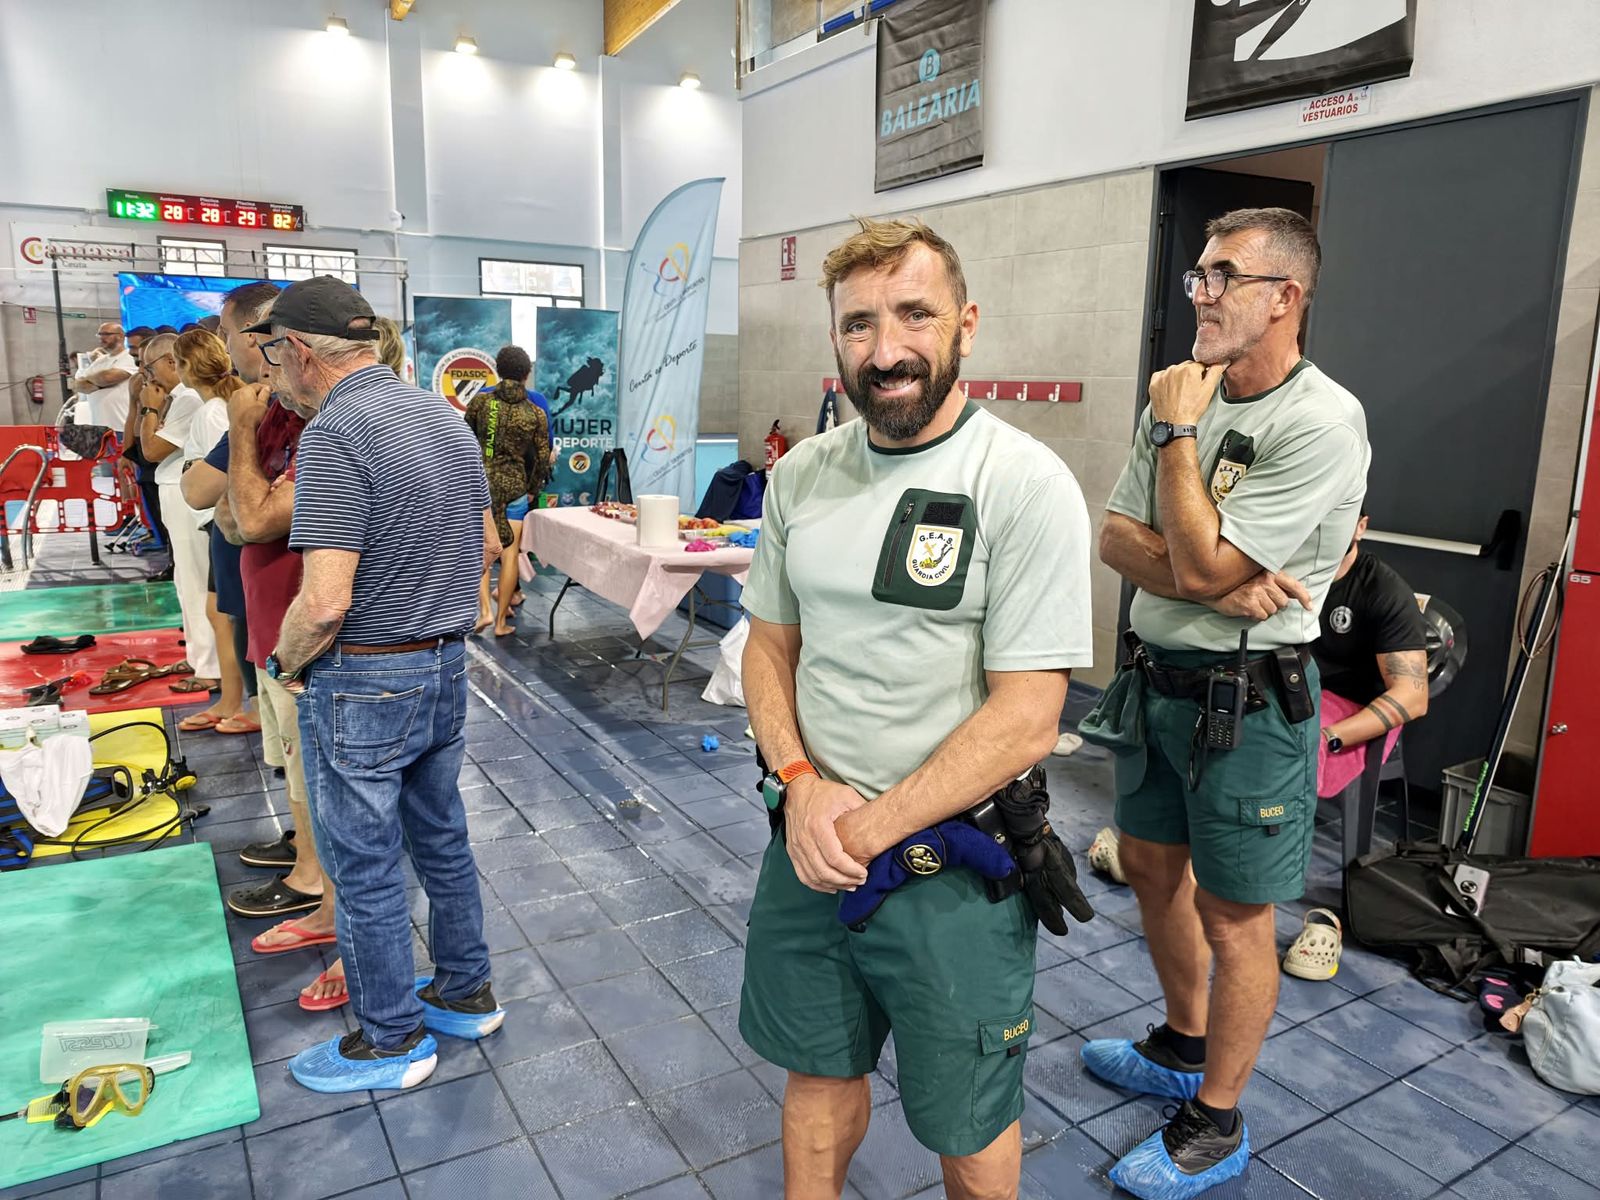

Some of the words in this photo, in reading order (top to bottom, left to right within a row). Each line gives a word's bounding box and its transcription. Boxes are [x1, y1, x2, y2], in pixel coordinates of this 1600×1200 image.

[880, 79, 980, 137] BALEARIA
[1309, 94, 1345, 110] ACCESO
[1347, 92, 1354, 103] A
[1302, 103, 1358, 122] VESTUARIOS
[163, 204, 183, 220] 28
[201, 207, 220, 223] 28
[238, 210, 256, 226] 29
[273, 213, 291, 229] 82
[450, 370, 488, 378] FDASDC
[553, 437, 613, 448] DEPORTE
[912, 558, 933, 580] GUARDIA
[934, 564, 950, 579] CIVIL
[1570, 575, 1591, 584] 65
[1260, 805, 1284, 818] BUCEO
[1003, 1019, 1029, 1041] BUCEO
